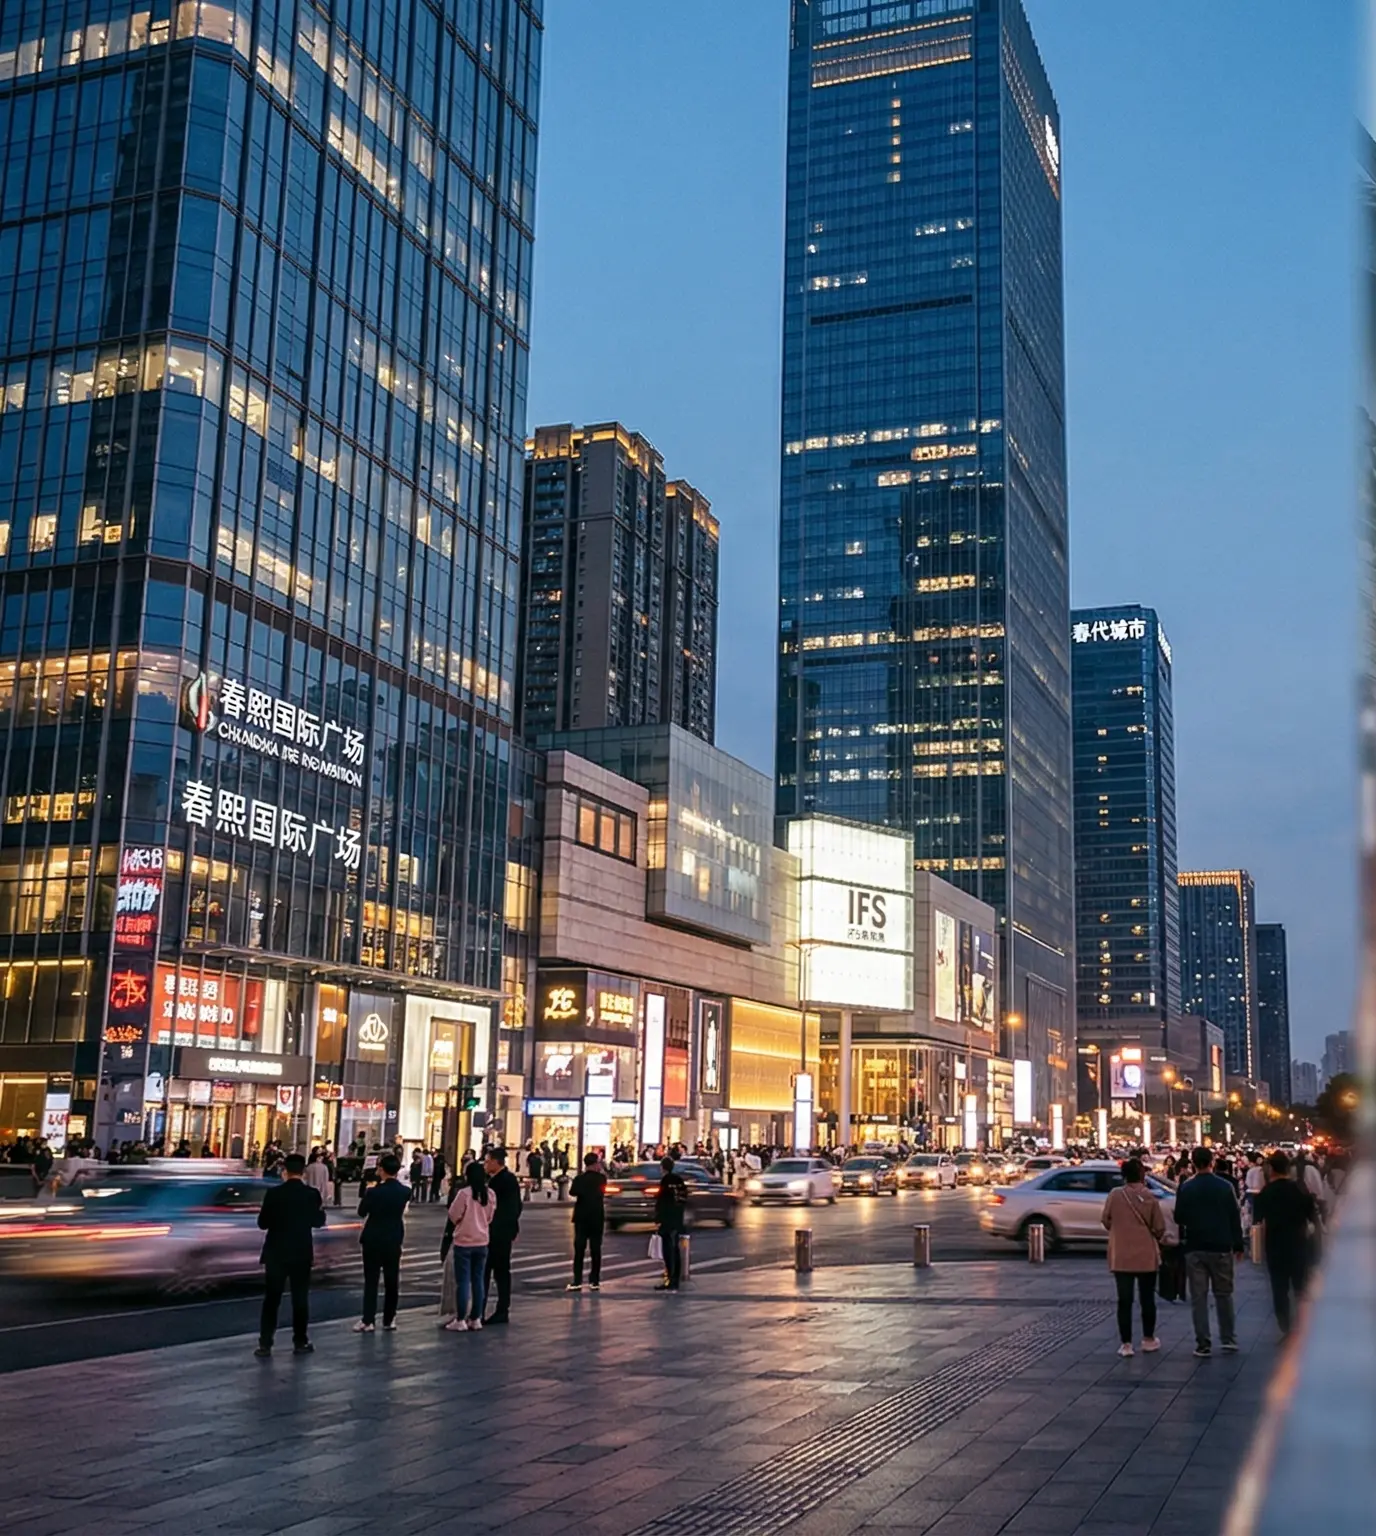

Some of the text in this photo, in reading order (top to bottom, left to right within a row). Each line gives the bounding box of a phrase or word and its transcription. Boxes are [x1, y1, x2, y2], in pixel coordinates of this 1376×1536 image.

[219, 678, 365, 766] 春熙国际广场
[181, 779, 362, 869] 春熙国际广场
[848, 889, 887, 929] IFS
